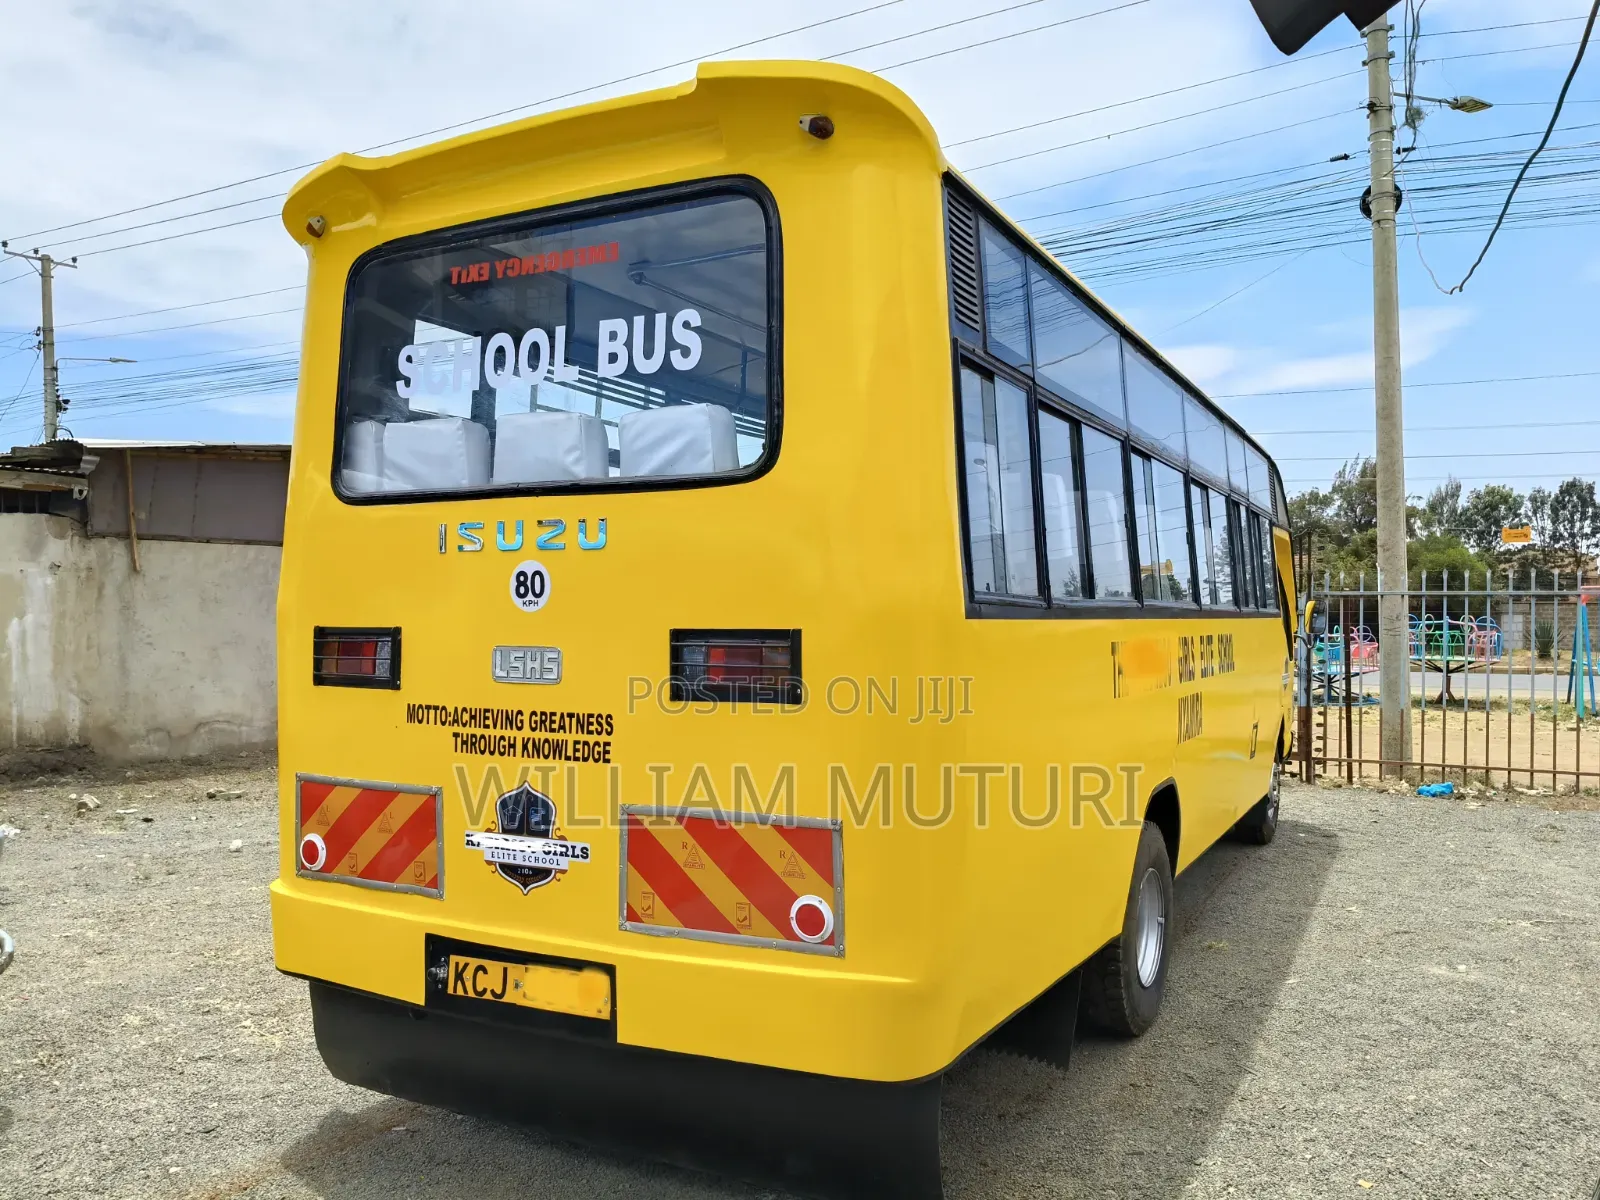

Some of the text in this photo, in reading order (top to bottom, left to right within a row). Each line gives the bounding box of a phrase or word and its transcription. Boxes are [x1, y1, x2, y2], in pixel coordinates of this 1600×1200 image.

[396, 308, 703, 399] SCHOOL BUS
[438, 517, 608, 555] ISUZU
[514, 569, 546, 600] 80
[522, 599, 539, 608] KPH
[494, 649, 560, 680] LSHS
[1178, 635, 1195, 684] GIRLS
[1200, 634, 1214, 679] ELITE
[529, 709, 614, 736] GREATNESS
[452, 731, 612, 763] THROUGH KNOWLEDGE
[491, 851, 561, 866] ELITE SCHOOL
[681, 841, 688, 850] R
[779, 850, 786, 859] R
[453, 961, 508, 1000] KCJ
